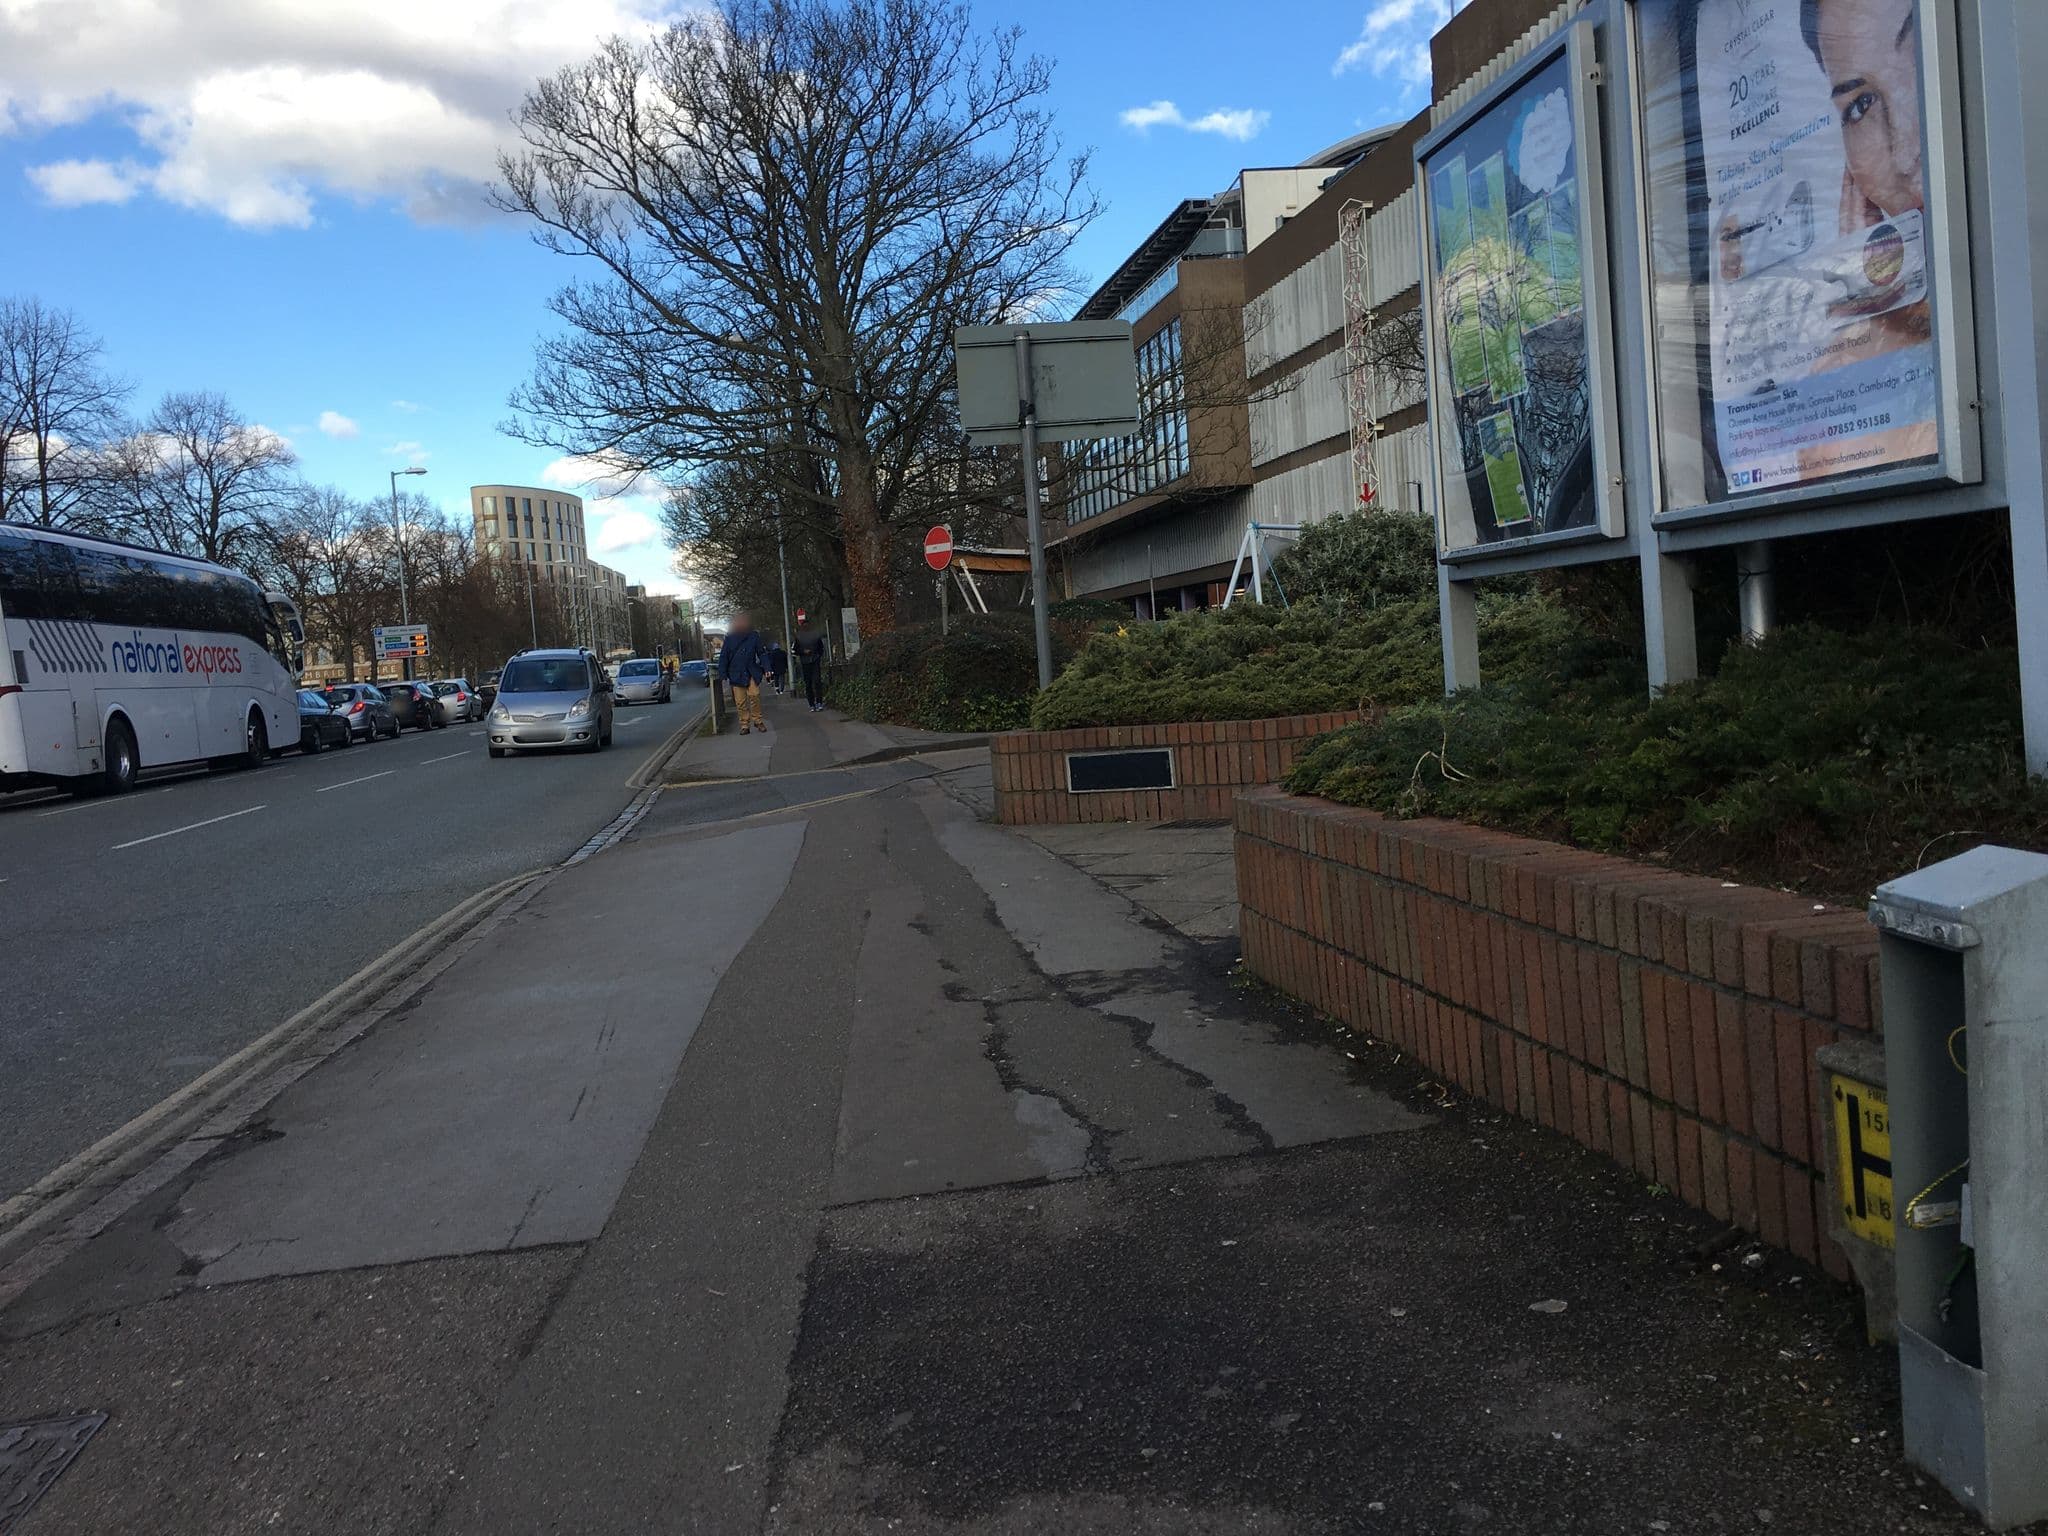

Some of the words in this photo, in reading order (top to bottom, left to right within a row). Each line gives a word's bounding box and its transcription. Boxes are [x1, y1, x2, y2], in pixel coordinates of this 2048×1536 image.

[1751, 9, 1775, 32] CLEAR
[1729, 74, 1748, 109] 20
[1730, 101, 1780, 141] EXCELLENCE
[1782, 387, 1799, 401] Skin
[1827, 420, 1855, 437] 07852
[1857, 412, 1891, 430] 951588
[112, 630, 183, 673] national
[183, 644, 242, 684] express
[1864, 1109, 1891, 1134] 15
